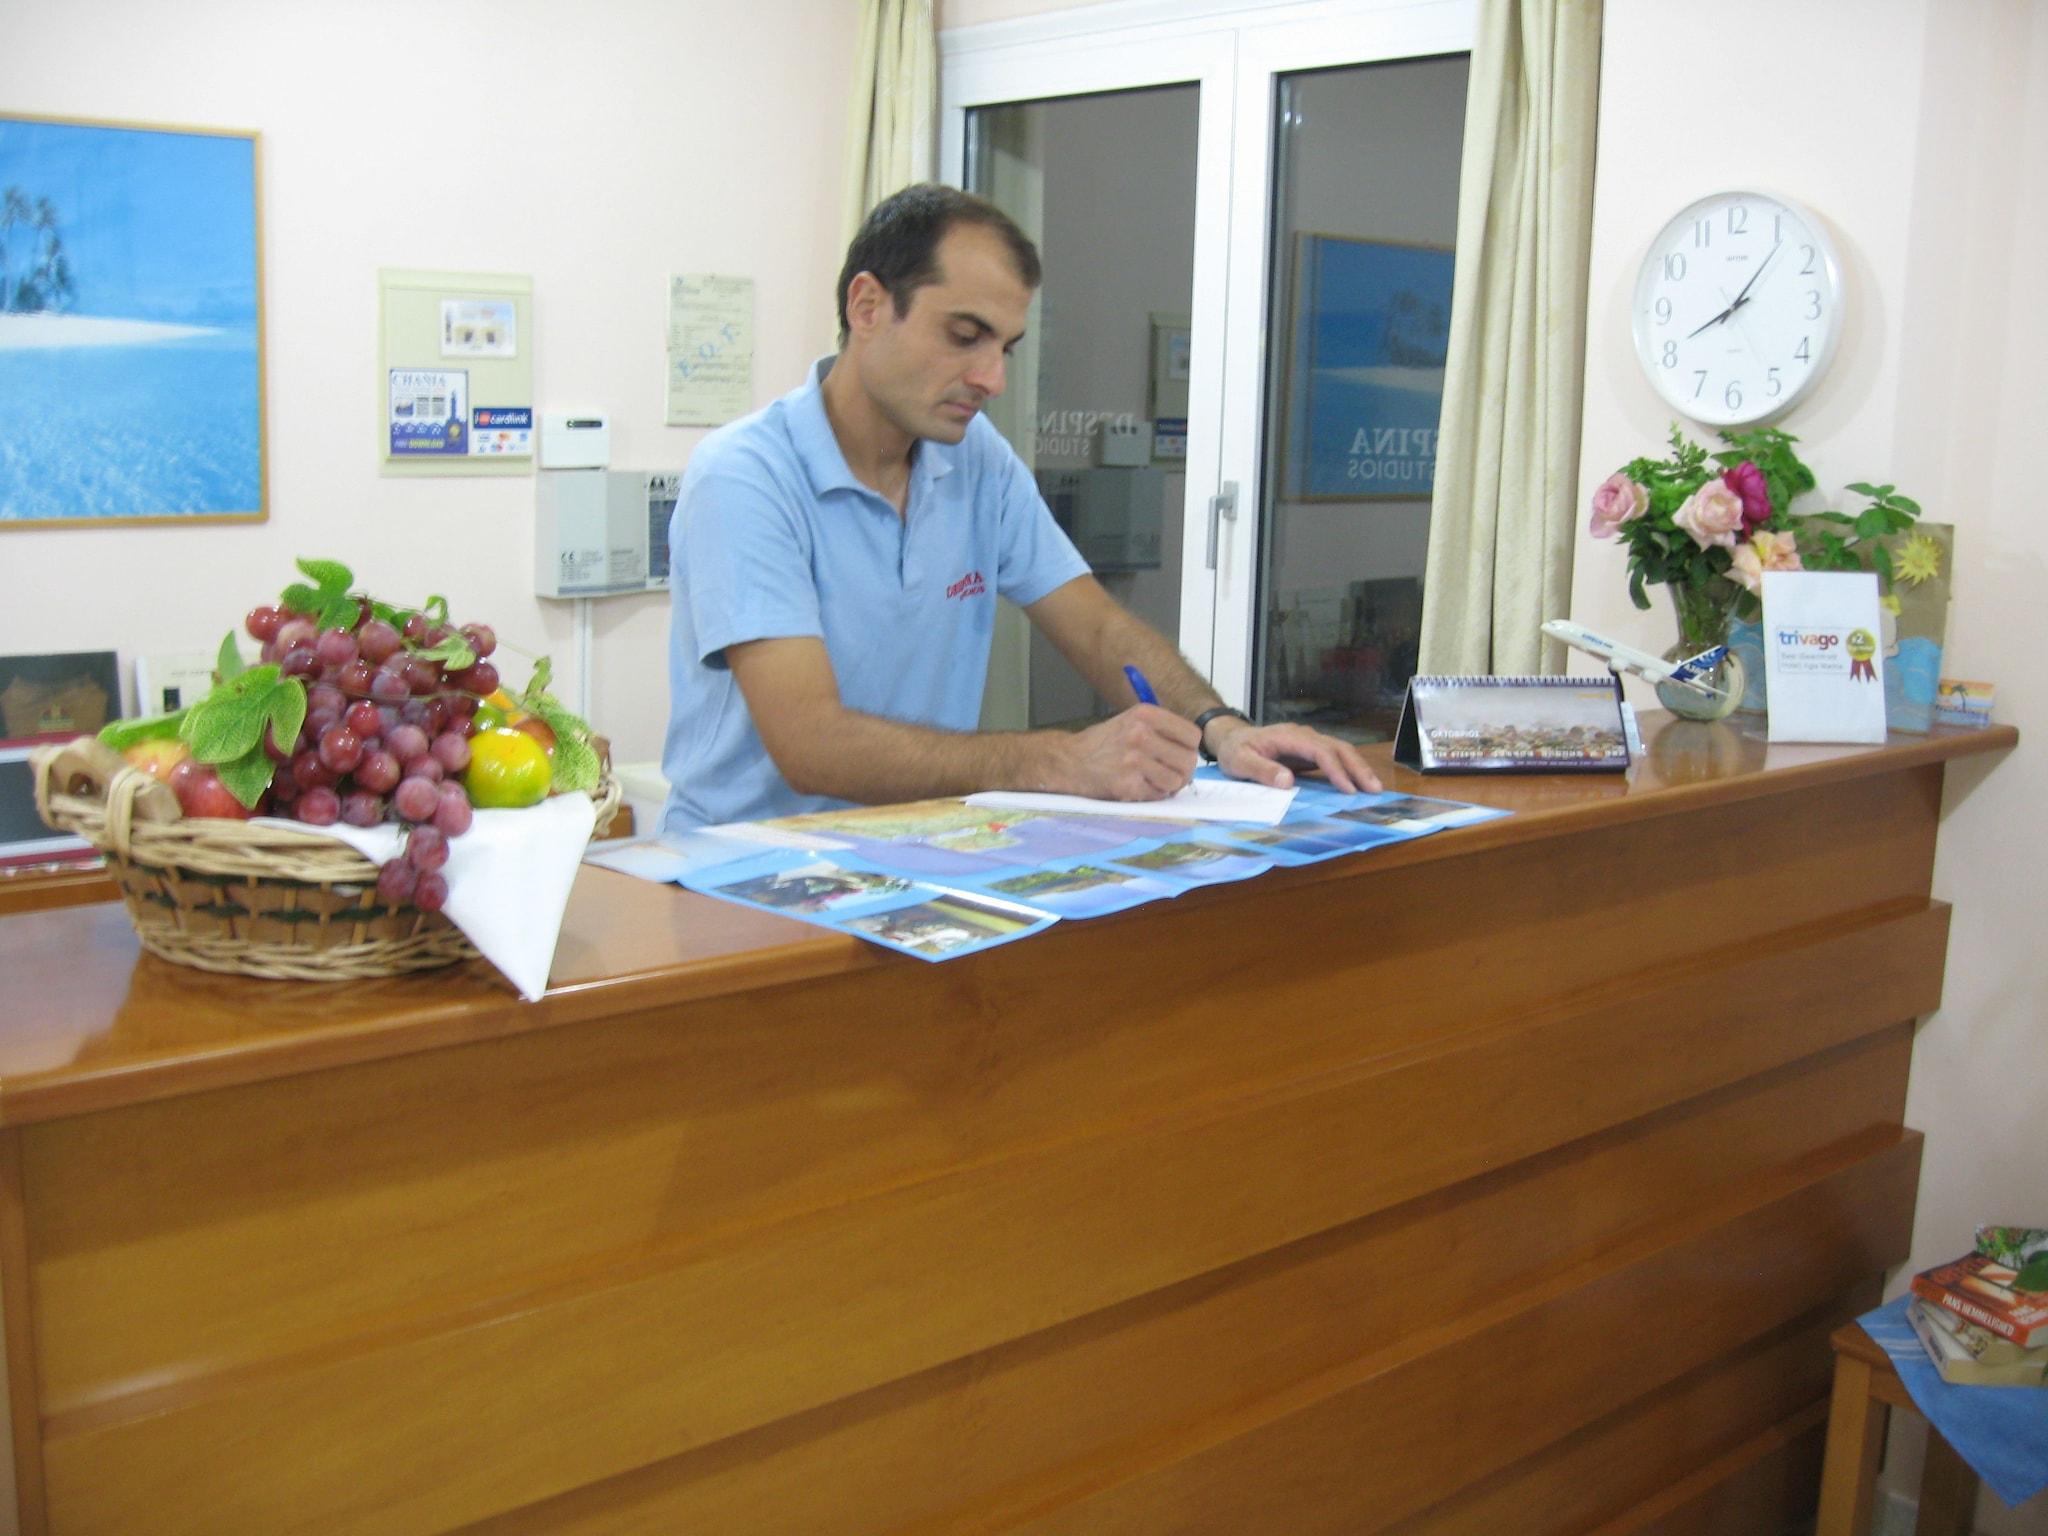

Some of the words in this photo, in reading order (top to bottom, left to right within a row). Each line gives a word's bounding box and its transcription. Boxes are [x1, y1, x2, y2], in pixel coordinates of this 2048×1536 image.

[1695, 220, 1710, 248] 11
[1727, 205, 1748, 234] 12
[1774, 214, 1781, 243] 1
[1664, 252, 1687, 282] 10
[1799, 244, 1816, 275] 2
[1655, 297, 1672, 326] 9
[1804, 290, 1822, 320] 3
[1662, 340, 1678, 369] 8
[1793, 336, 1811, 365] 4
[1693, 370, 1708, 398] 7
[1725, 380, 1742, 410] 6
[1766, 367, 1782, 397] 5
[490, 411, 529, 425] cardlink
[1779, 630, 1839, 651] trivago
